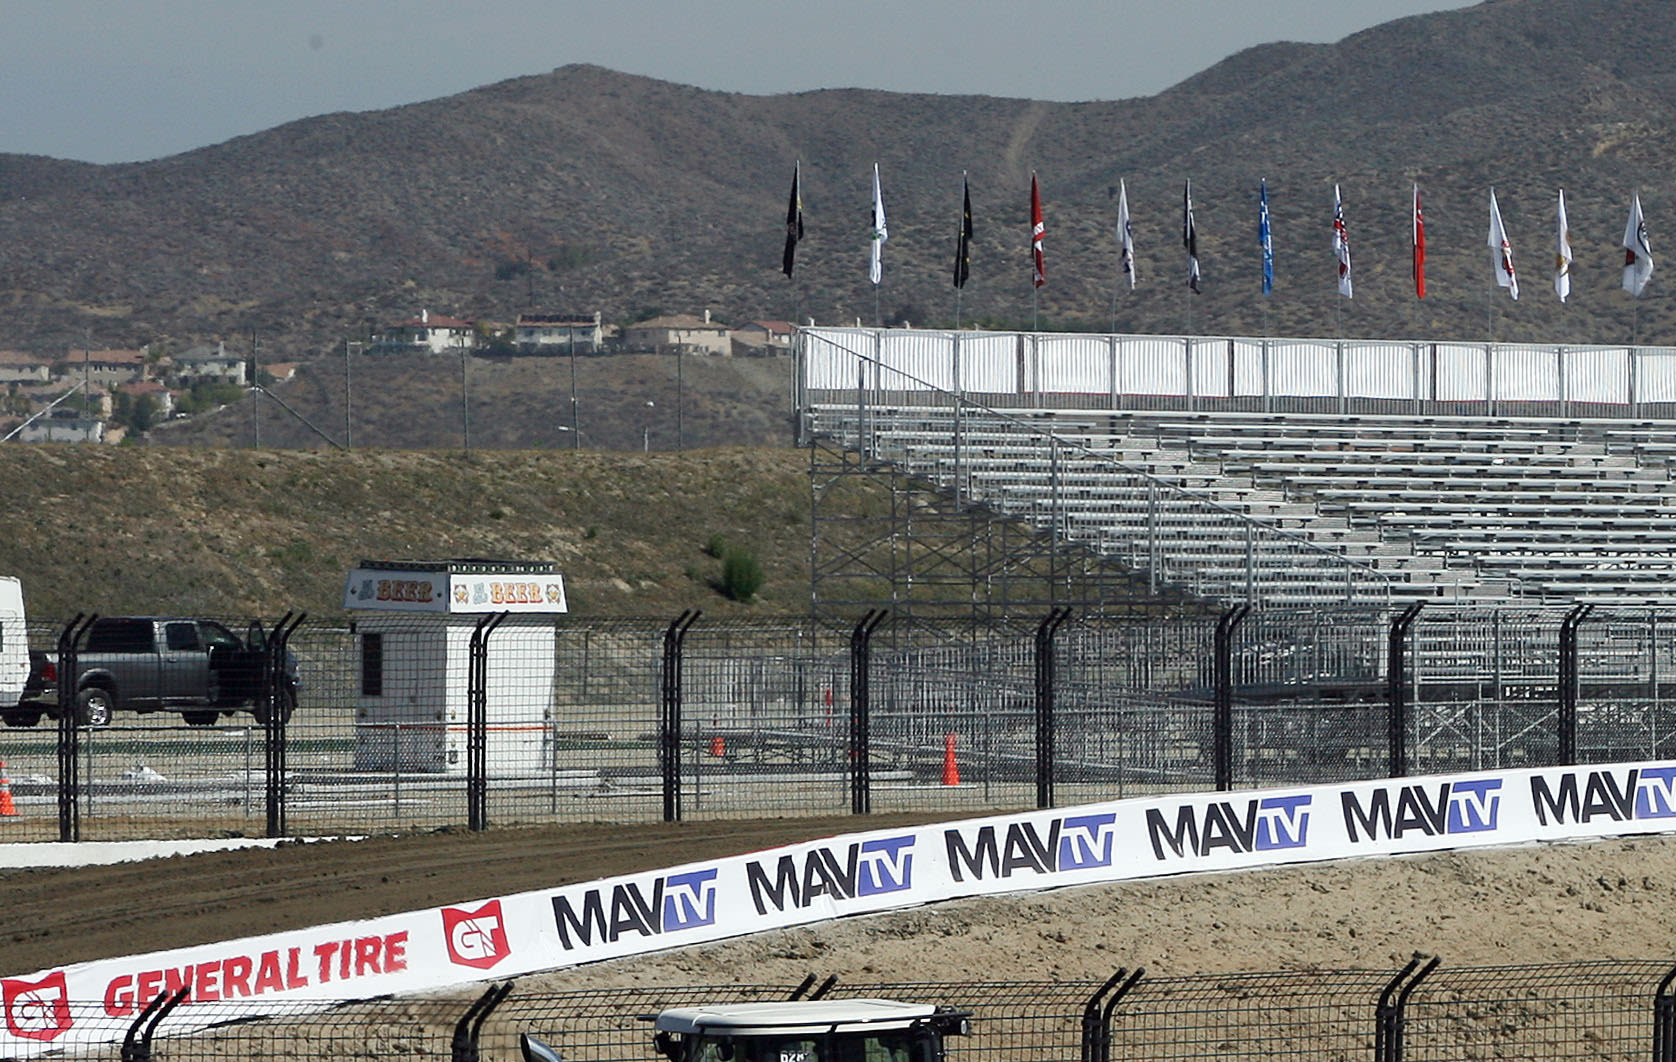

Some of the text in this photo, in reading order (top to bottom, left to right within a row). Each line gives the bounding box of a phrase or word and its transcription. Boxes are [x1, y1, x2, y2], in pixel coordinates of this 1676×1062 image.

[377, 580, 432, 602] BEER
[490, 582, 543, 604] BEER
[1146, 795, 1312, 861] MAVTV
[1341, 779, 1503, 843] MAVTV
[746, 835, 916, 916] MAVTV
[944, 813, 1116, 883] MAVTV
[552, 868, 718, 951] MAVTV
[104, 930, 410, 1016] GENERAL TIRE
